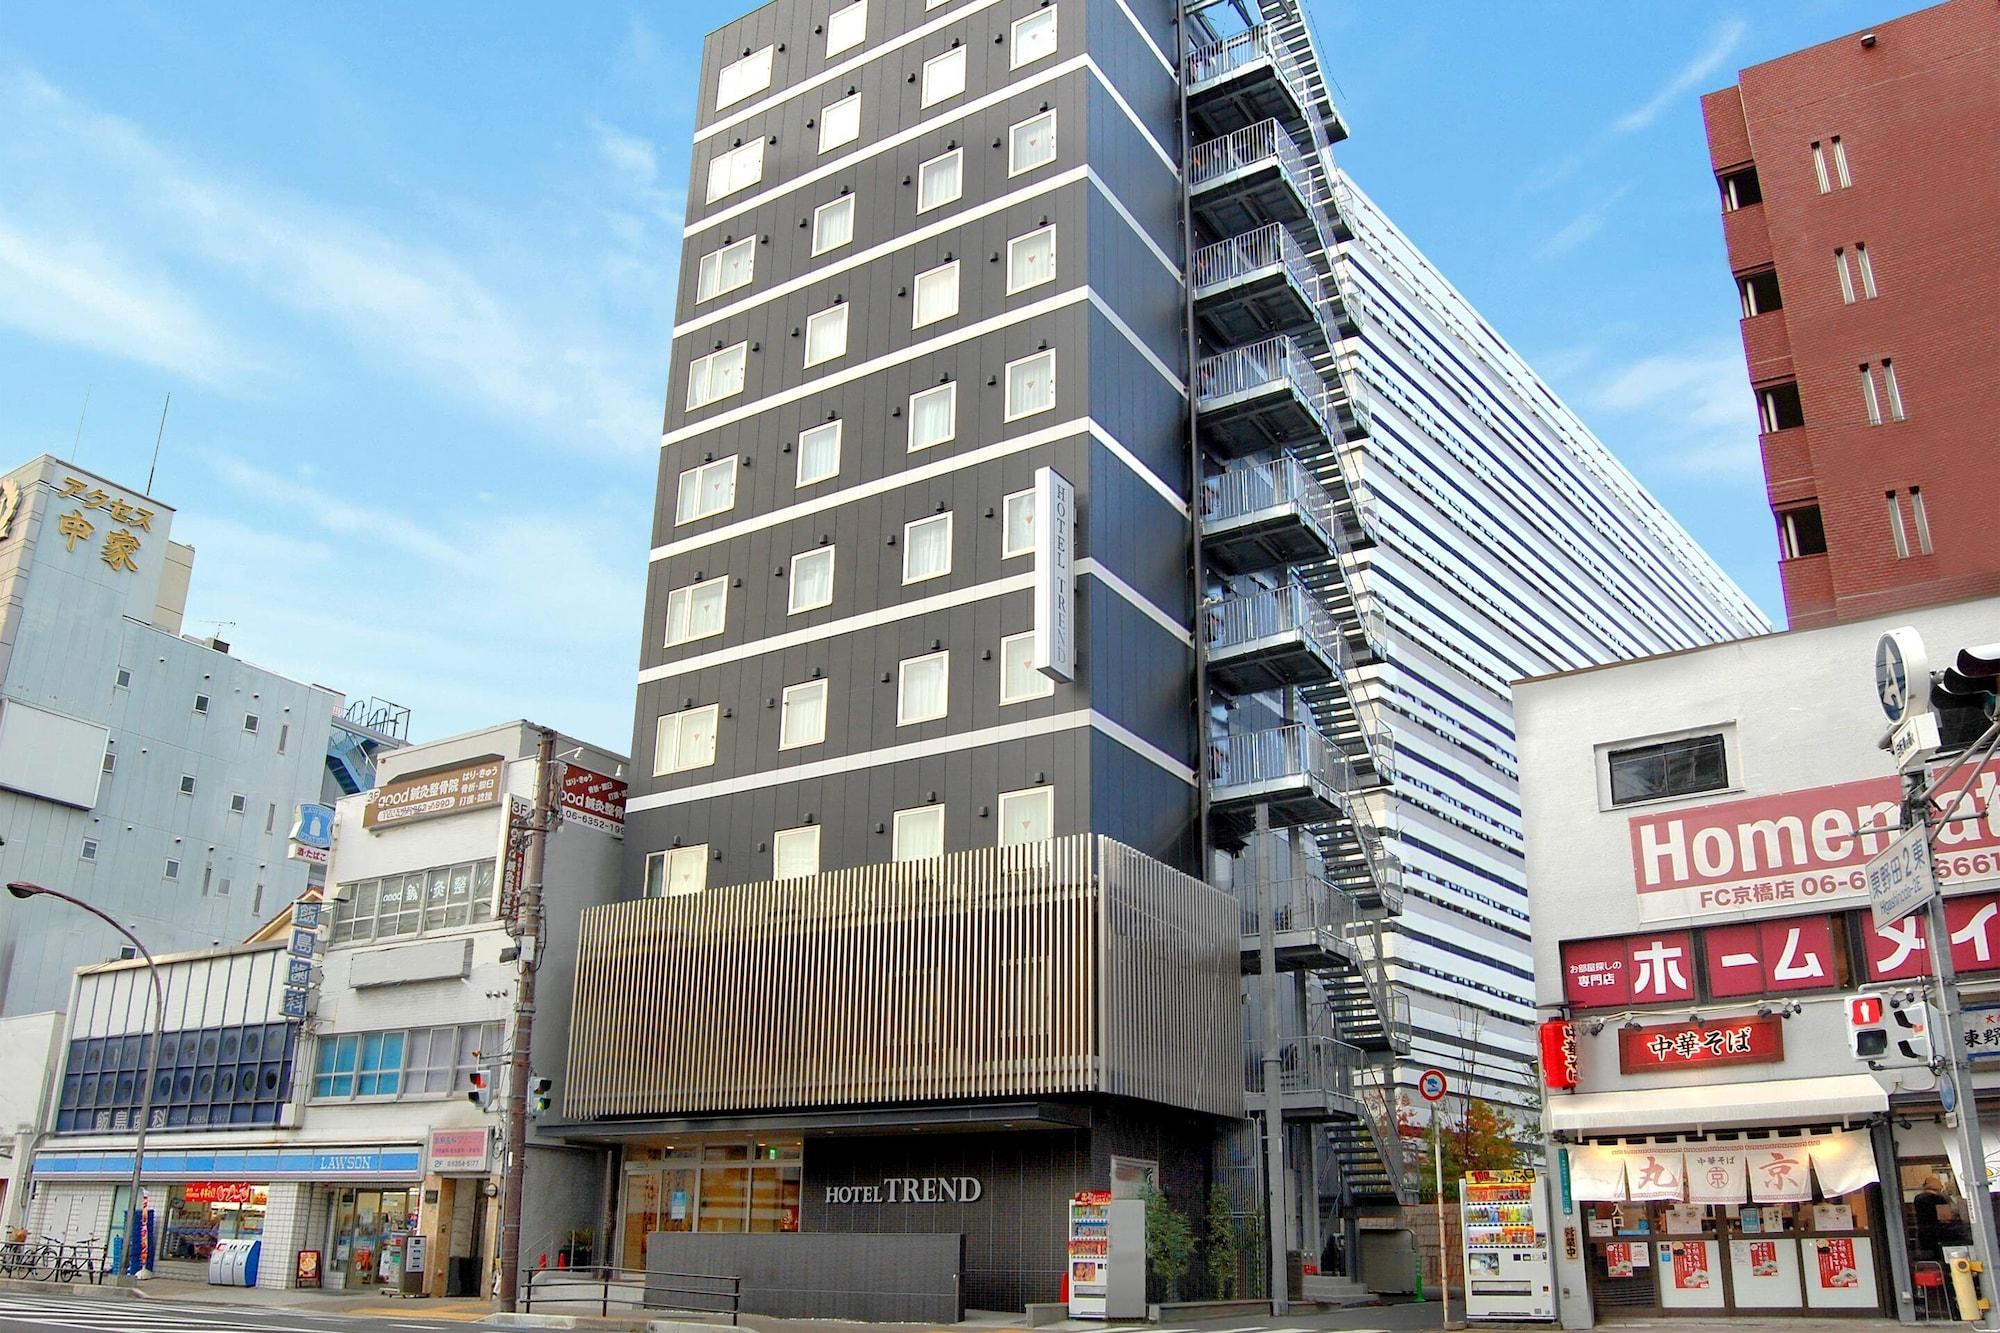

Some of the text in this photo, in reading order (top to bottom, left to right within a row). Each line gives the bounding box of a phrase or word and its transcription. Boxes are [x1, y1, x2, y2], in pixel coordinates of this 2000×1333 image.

[58, 476, 156, 533] アクセス
[1057, 484, 1067, 664] HOTEL TREND
[512, 801, 528, 814] 3F
[1870, 838, 1926, 900] 東野田2東
[1700, 879, 1796, 909] FC京橋店
[1569, 961, 1622, 974] お部屋探しの
[1578, 972, 1615, 988] 専門店
[1647, 1028, 1752, 1062] 中華そば
[320, 1156, 371, 1170] LAWSON
[1638, 1152, 1802, 1191] 丸 京
[1697, 1155, 1736, 1167] 中華そば
[825, 1176, 982, 1204] HOTEL TREND
